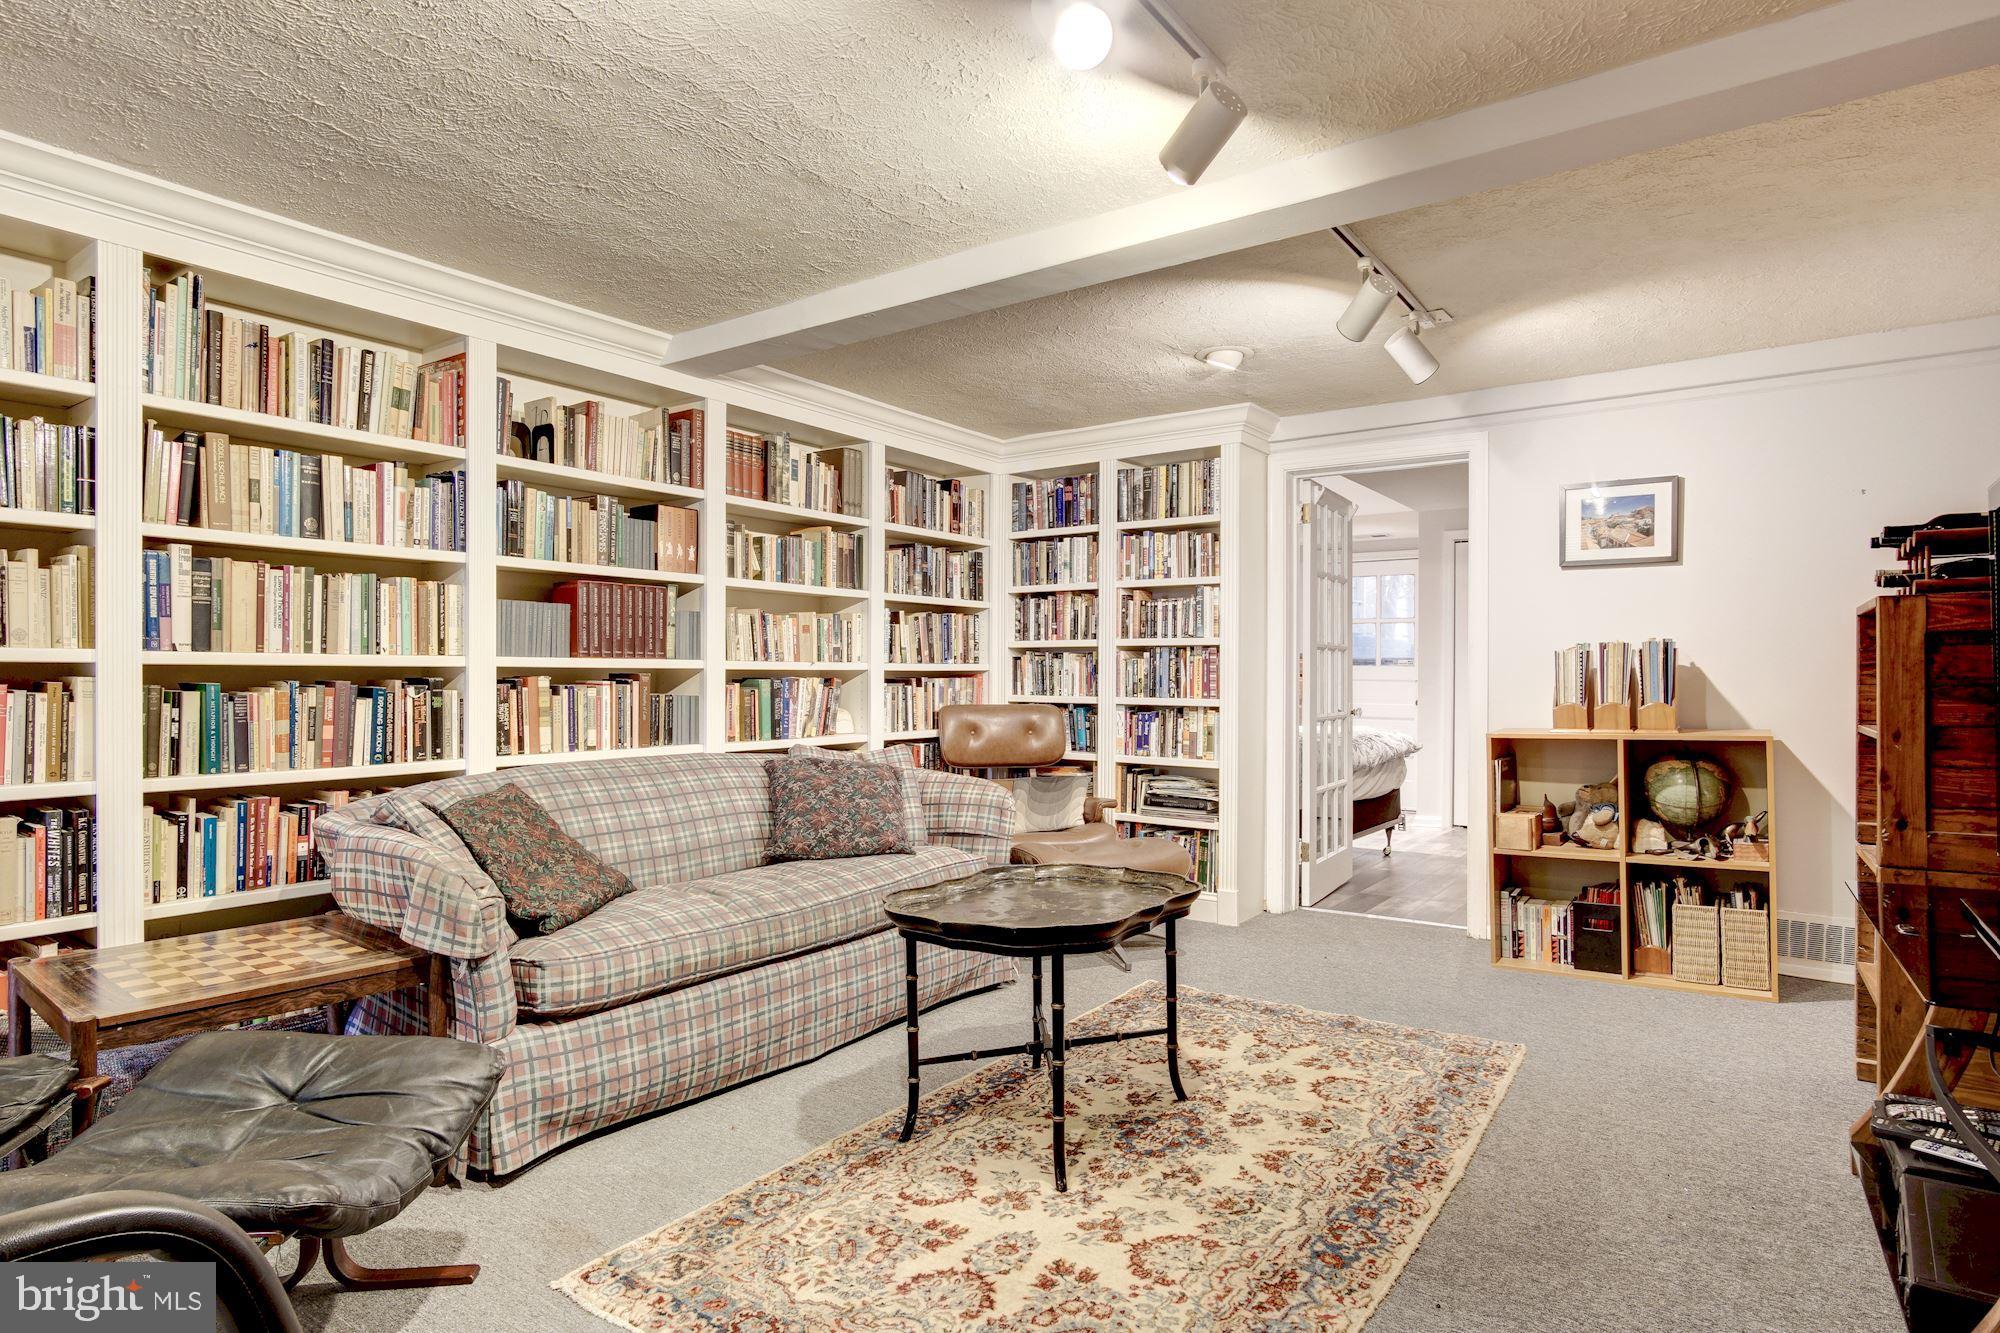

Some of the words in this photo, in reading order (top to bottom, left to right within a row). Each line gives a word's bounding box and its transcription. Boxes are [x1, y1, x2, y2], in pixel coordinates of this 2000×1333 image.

[216, 352, 221, 360] TO
[227, 336, 238, 377] Watership
[228, 378, 238, 404] Down
[696, 448, 701, 458] OF
[47, 829, 61, 867] WHITES
[78, 830, 88, 865] CONSTANTINE
[78, 872, 88, 901] GRIEVANCE
